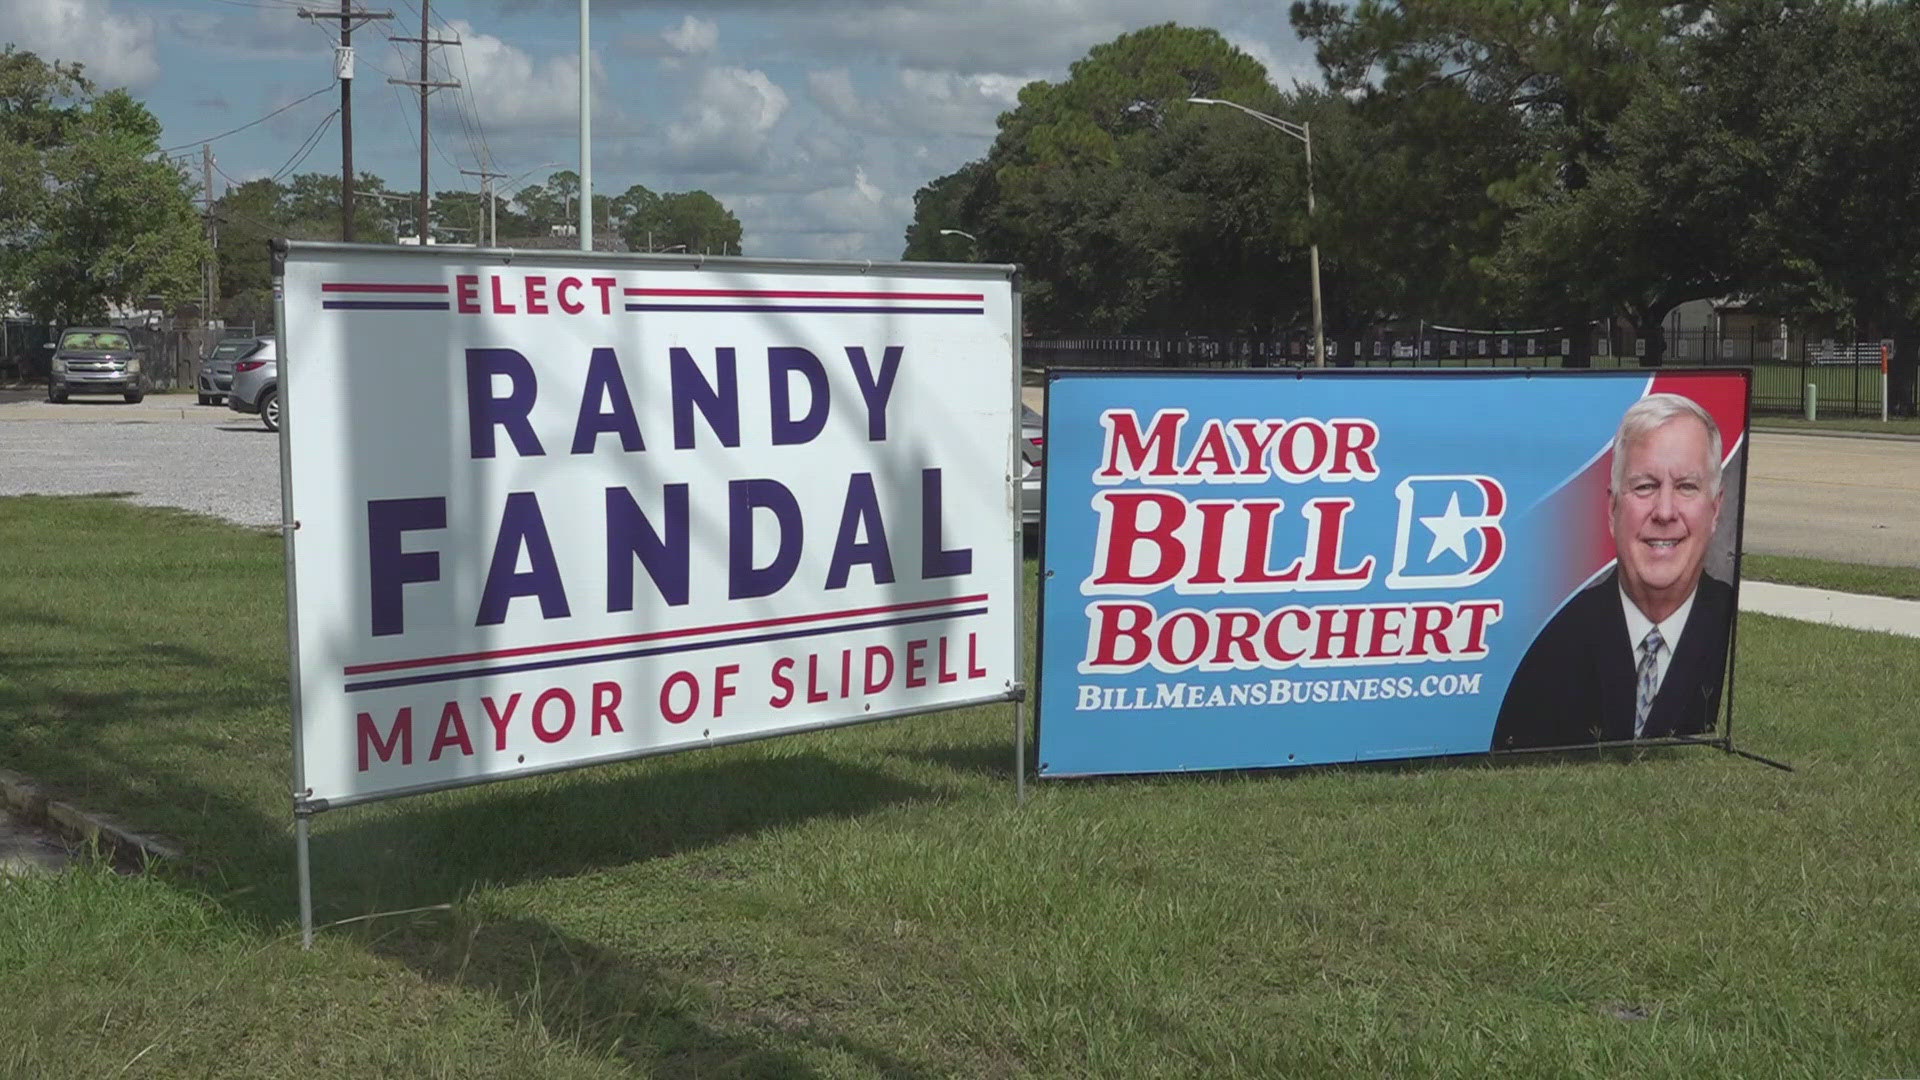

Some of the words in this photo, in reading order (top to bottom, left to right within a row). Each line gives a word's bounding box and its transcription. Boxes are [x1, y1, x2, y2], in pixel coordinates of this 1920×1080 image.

[456, 274, 617, 316] ELECT
[465, 346, 905, 459] RANDY
[1097, 410, 1379, 480] MAYOR
[367, 467, 973, 637] FANDAL
[1090, 491, 1375, 589] BILL
[1087, 601, 1502, 670] BORCHERT
[356, 680, 624, 772] MAYOR
[659, 664, 740, 725] OF
[769, 632, 988, 709] SLIDELL
